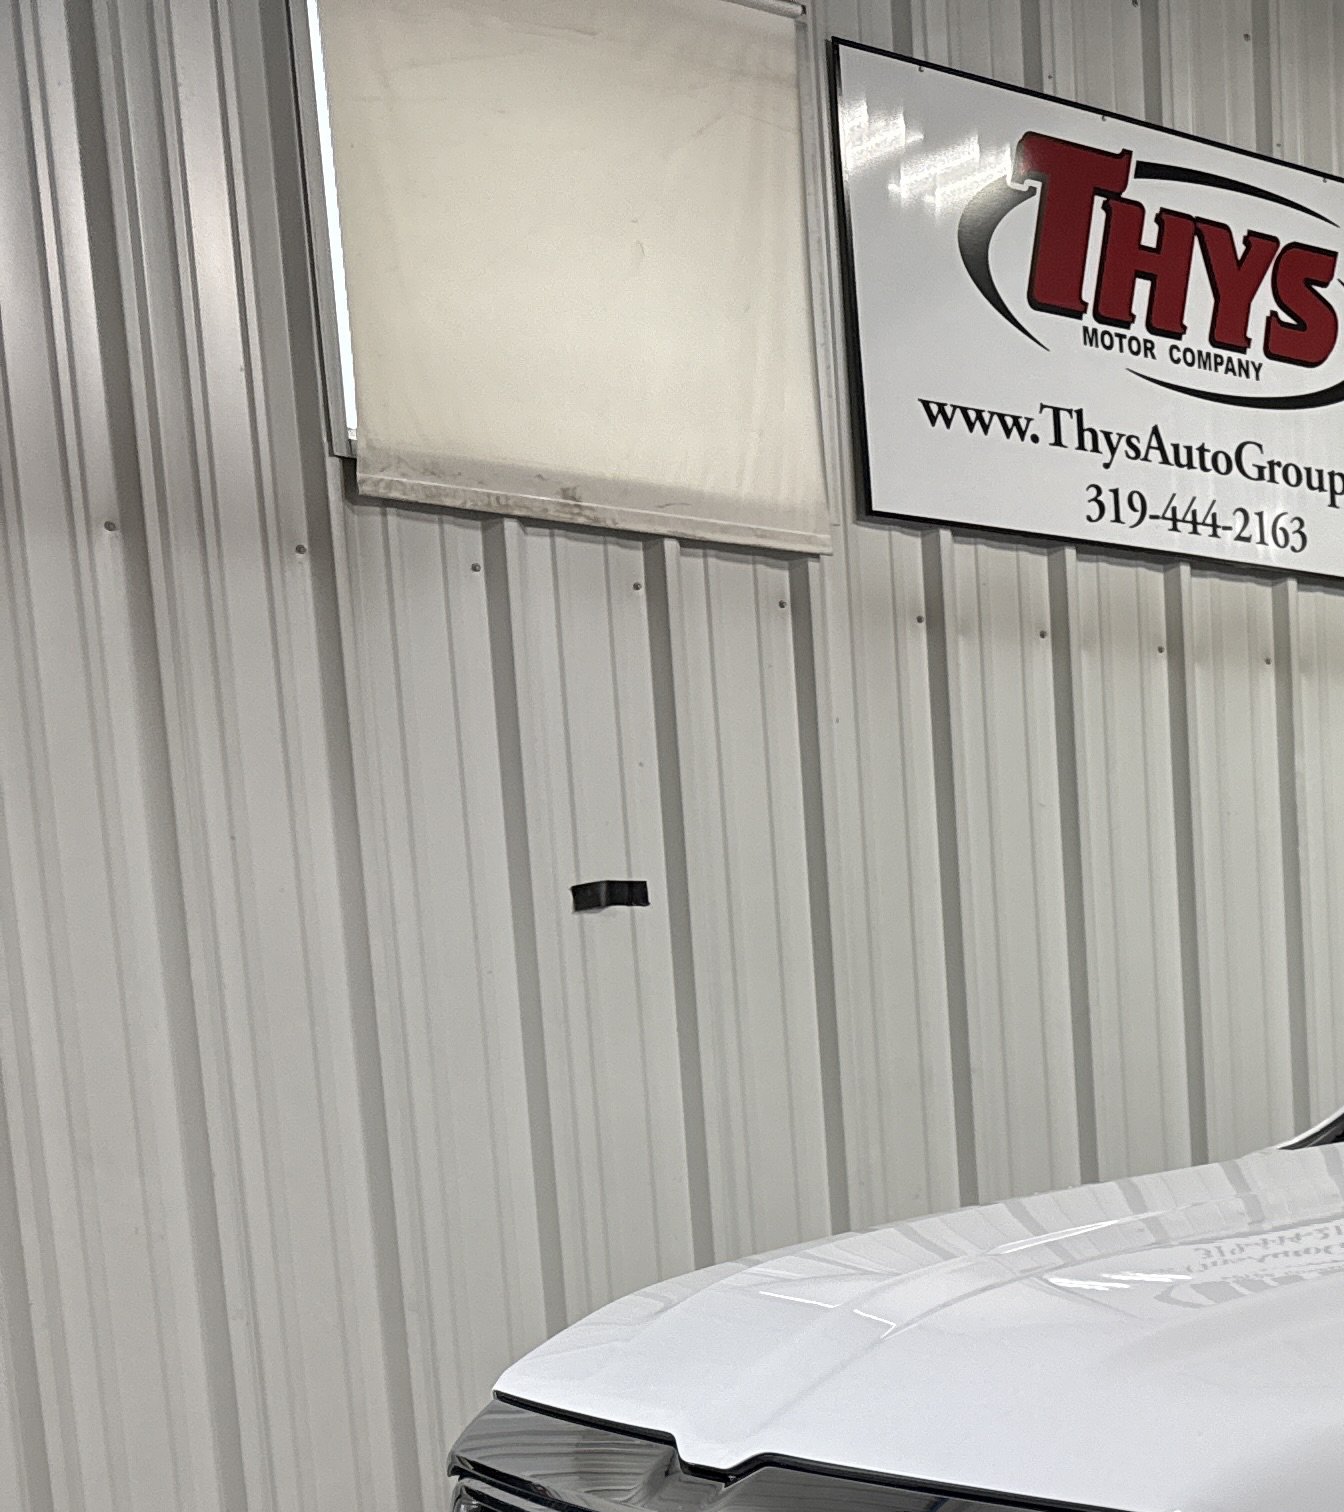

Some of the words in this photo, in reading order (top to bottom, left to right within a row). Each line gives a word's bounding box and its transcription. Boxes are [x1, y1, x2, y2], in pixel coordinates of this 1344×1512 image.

[1014, 131, 1338, 367] THYS
[1082, 326, 1156, 361] MOTOR
[1169, 344, 1264, 382] COMPANY
[1085, 484, 1308, 553] 319-444-2163
